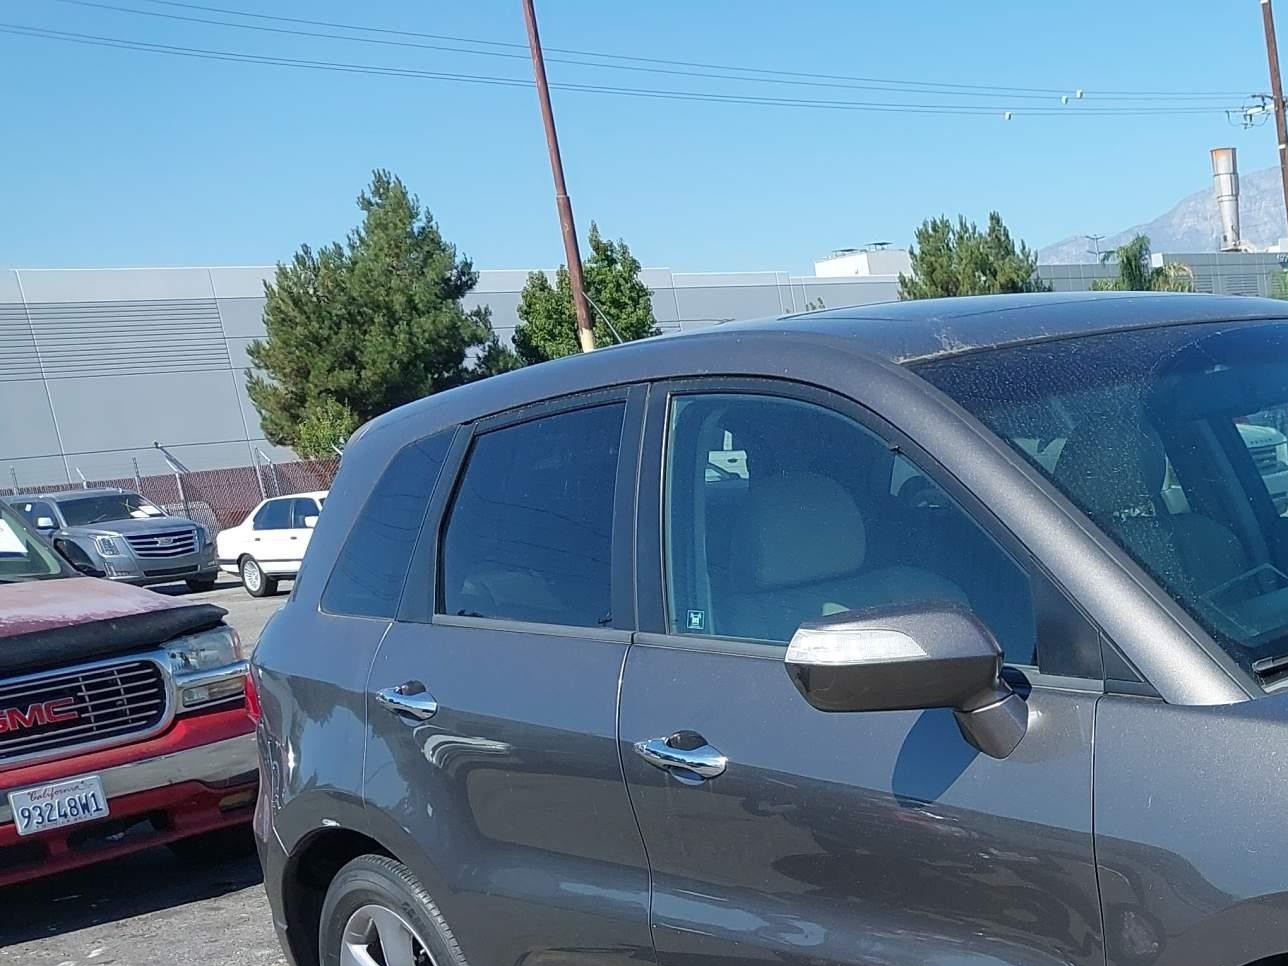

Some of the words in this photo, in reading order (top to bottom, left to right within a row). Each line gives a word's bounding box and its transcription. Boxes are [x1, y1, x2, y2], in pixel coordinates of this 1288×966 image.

[0, 697, 78, 732] MC
[20, 792, 103, 829] 93248W1
[30, 785, 80, 801] California
